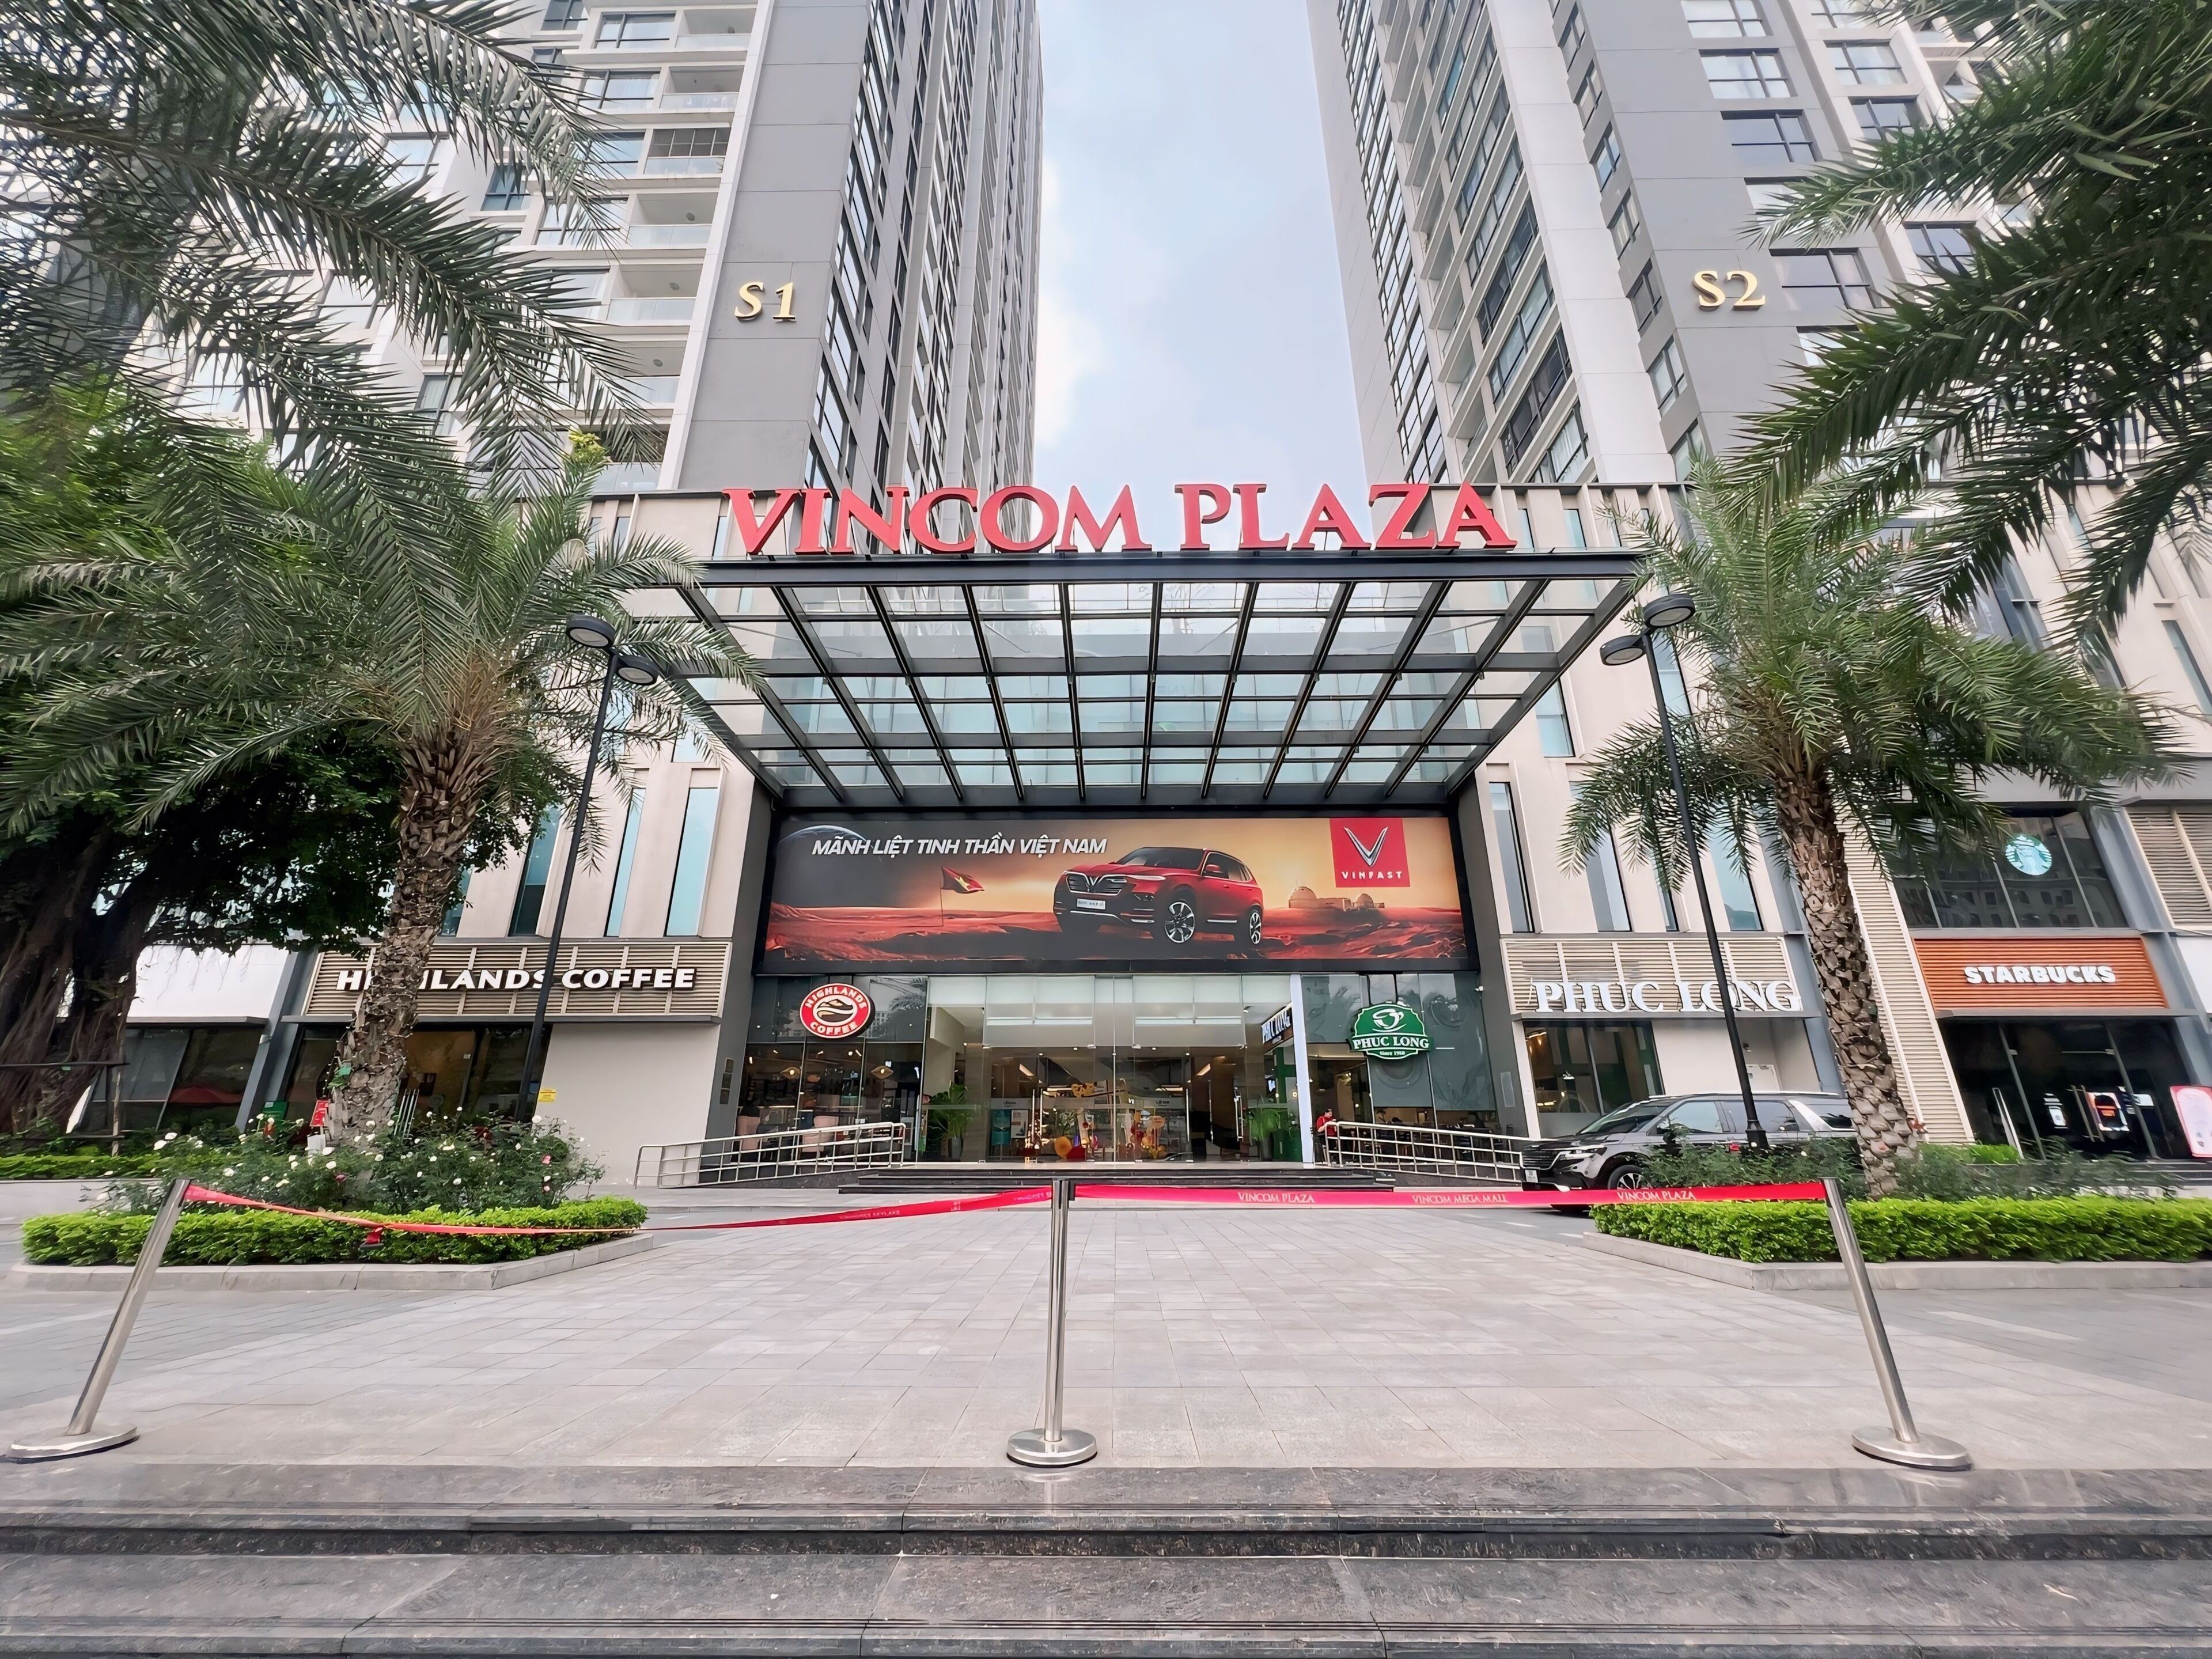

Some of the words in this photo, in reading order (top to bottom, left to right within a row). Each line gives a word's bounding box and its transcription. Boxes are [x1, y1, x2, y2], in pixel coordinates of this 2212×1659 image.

[1692, 270, 1766, 311] S2
[734, 282, 796, 321] S1
[722, 484, 1152, 555] VINCOM
[1175, 481, 1517, 551] PLAZA
[812, 836, 871, 855] MÃNH
[873, 834, 914, 858] LIỆT
[918, 839, 960, 855] TINH
[965, 832, 1016, 854] THẦN
[1020, 834, 1060, 858] VIỆT
[1062, 838, 1107, 854] NAM
[1341, 871, 1402, 880] VINFAST
[336, 969, 546, 990] HILANDS
[562, 968, 695, 989] COFFEE
[1964, 965, 2116, 984] STARBUCKS
[804, 986, 868, 1009] HIGHLANDS
[1532, 981, 1664, 1013] PHUC
[1674, 980, 1804, 1013] LONG
[810, 1021, 858, 1036] COFFEE
[1352, 1037, 1389, 1050] PHUC
[1392, 1036, 1429, 1048] LONG
[1237, 1192, 1280, 1202] VINCOM
[1282, 1193, 1315, 1203] PLAZA
[1412, 1195, 1452, 1204] VINCOM
[1453, 1194, 1482, 1203] MEGA
[1482, 1194, 1509, 1203] MALL
[1616, 1191, 1662, 1201] VINCOM
[1662, 1191, 1697, 1200] PLAZA
